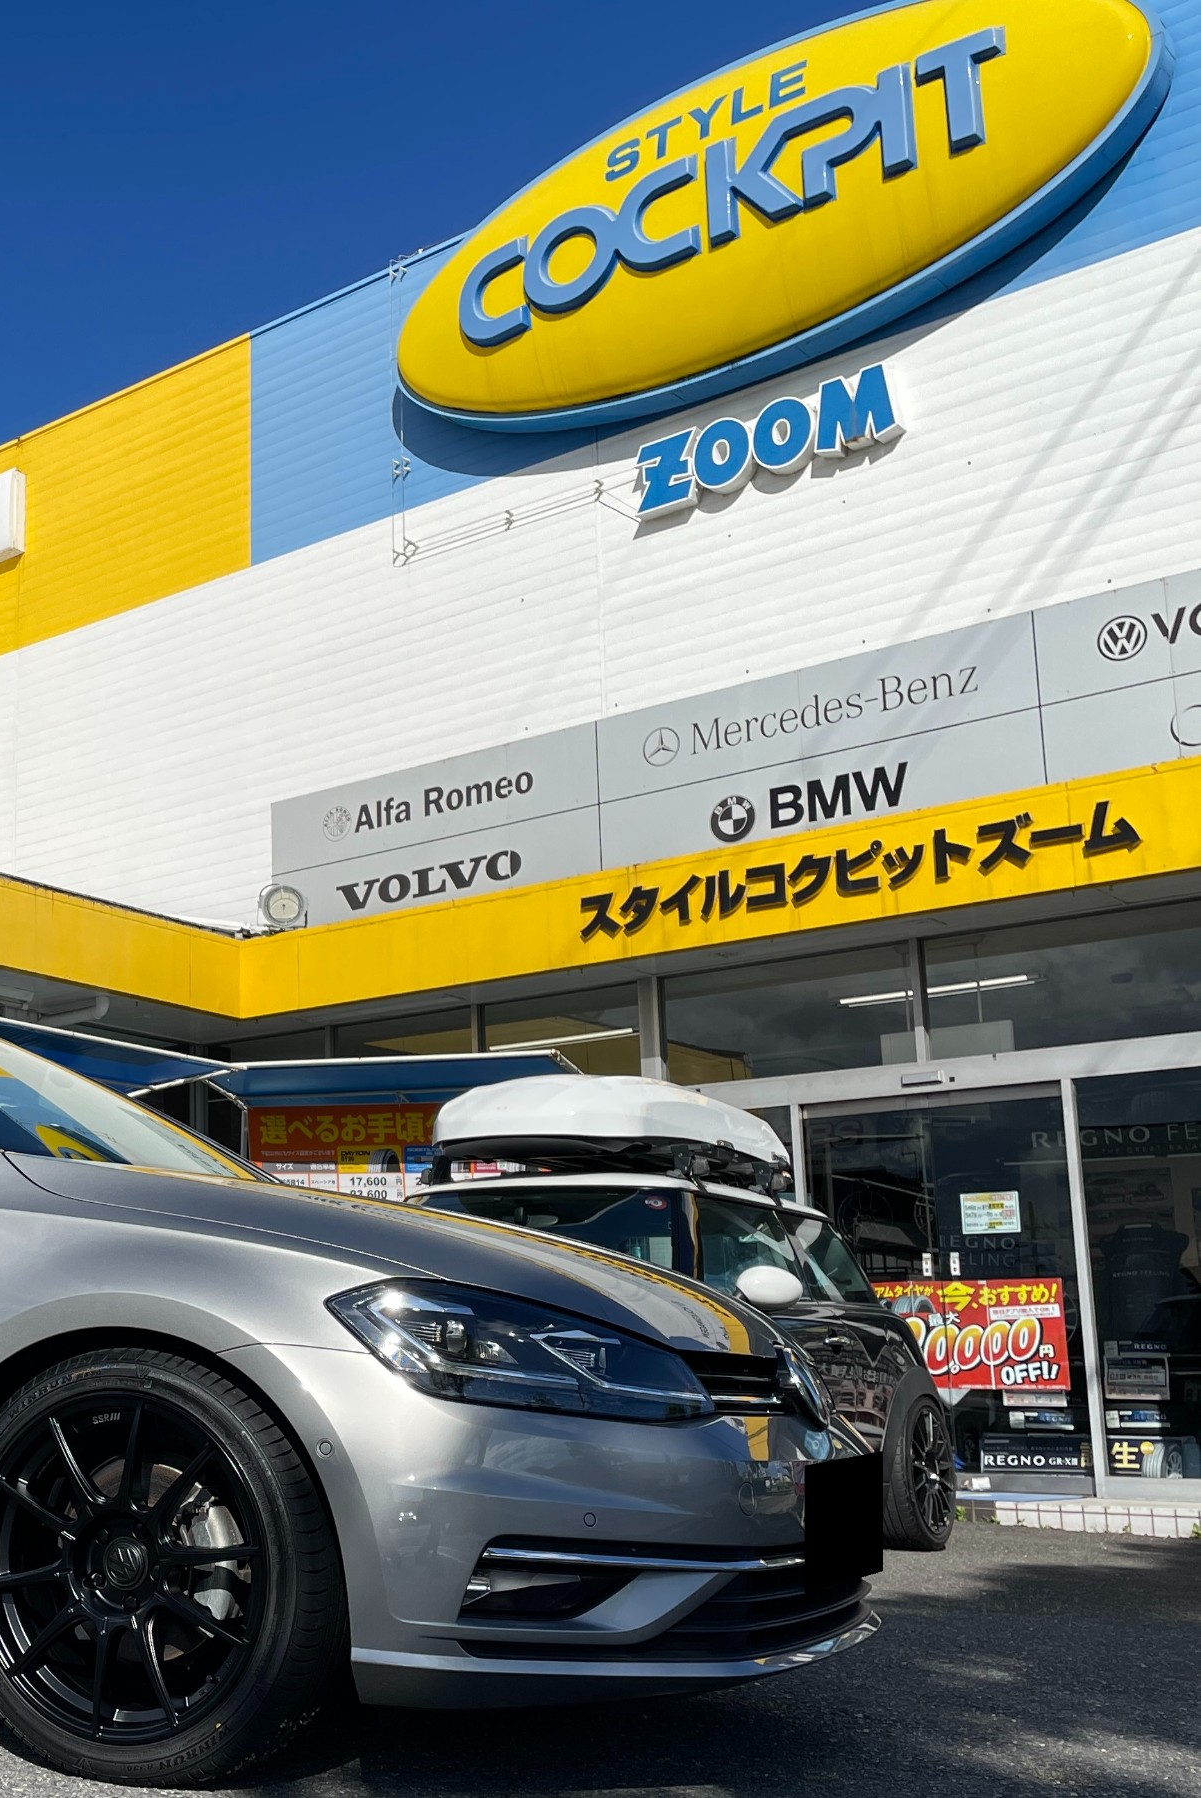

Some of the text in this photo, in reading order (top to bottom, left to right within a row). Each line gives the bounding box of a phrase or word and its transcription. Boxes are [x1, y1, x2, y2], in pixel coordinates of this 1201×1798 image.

[606, 60, 807, 183] STYLE
[459, 26, 1006, 348] COCKPIT
[636, 362, 907, 521] ZOOM
[691, 664, 980, 755] Mercedes-Benz
[354, 797, 411, 834] Alfa
[424, 771, 534, 818] Romeo
[769, 761, 909, 830] BMW
[336, 849, 522, 911] VOLVO
[580, 800, 1143, 944] スタイルコクピットズーム
[260, 1112, 434, 1145] 選べるお手頃
[349, 1176, 387, 1187] 17,600
[928, 1311, 961, 1327] 最大
[1000, 1360, 1060, 1385] OFF!!
[1039, 1344, 1055, 1359] 円
[984, 1454, 1046, 1467] REGNO
[1110, 1441, 1141, 1469] 生
